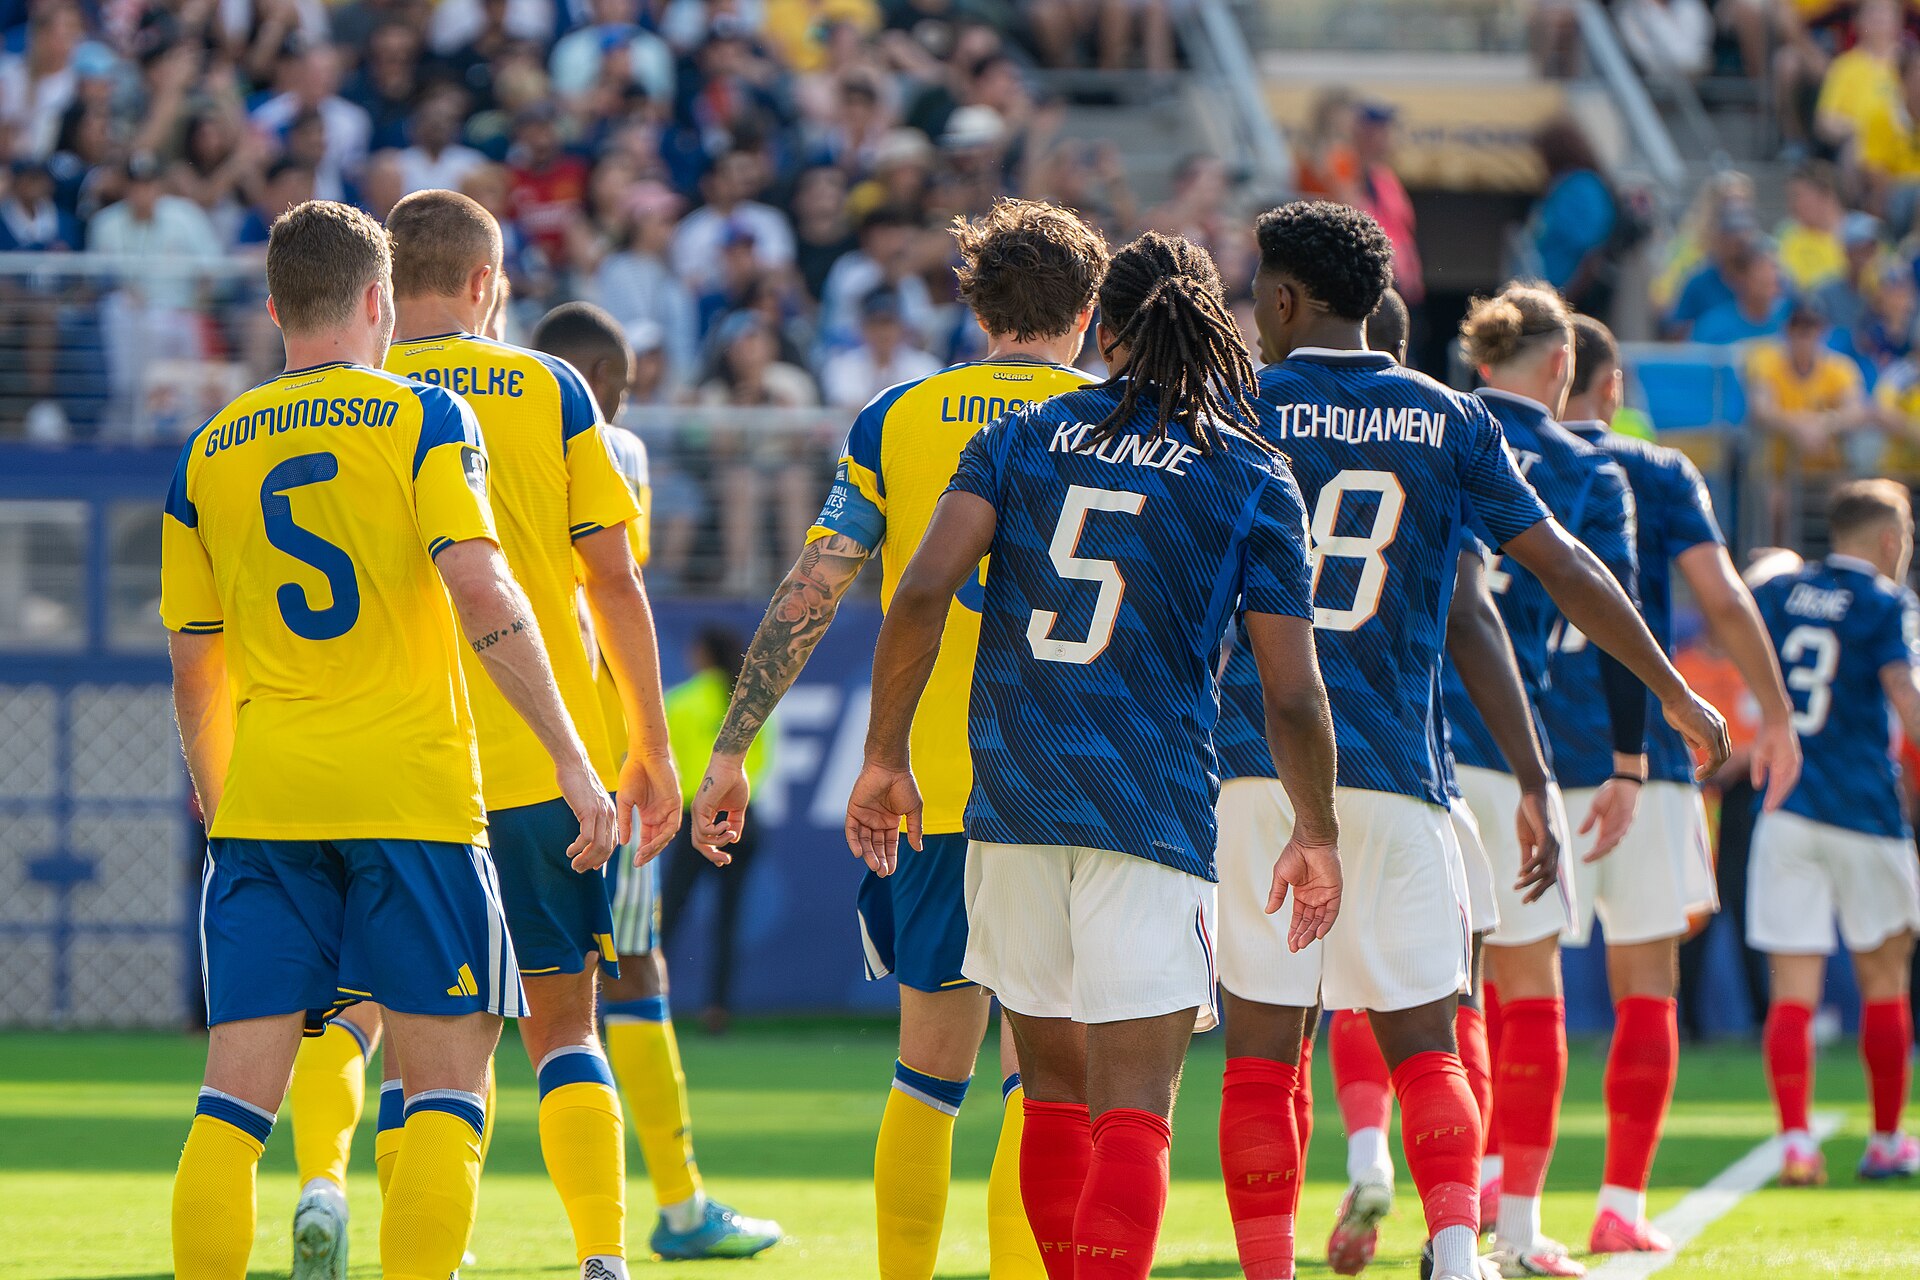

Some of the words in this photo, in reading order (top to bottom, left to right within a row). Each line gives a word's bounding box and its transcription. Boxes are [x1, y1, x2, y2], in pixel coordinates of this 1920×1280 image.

[204, 397, 399, 458] GUDMUNDSSON
[1275, 403, 1446, 449] TCHOUAMENI
[260, 451, 361, 641] 5
[1310, 469, 1407, 632] 8
[1025, 484, 1148, 665] 5
[1781, 624, 1840, 737] 3
[1415, 1126, 1467, 1146] FFF
[1246, 1168, 1296, 1185] FFF
[1041, 1241, 1072, 1253] FF
[1076, 1244, 1128, 1259] FFF
